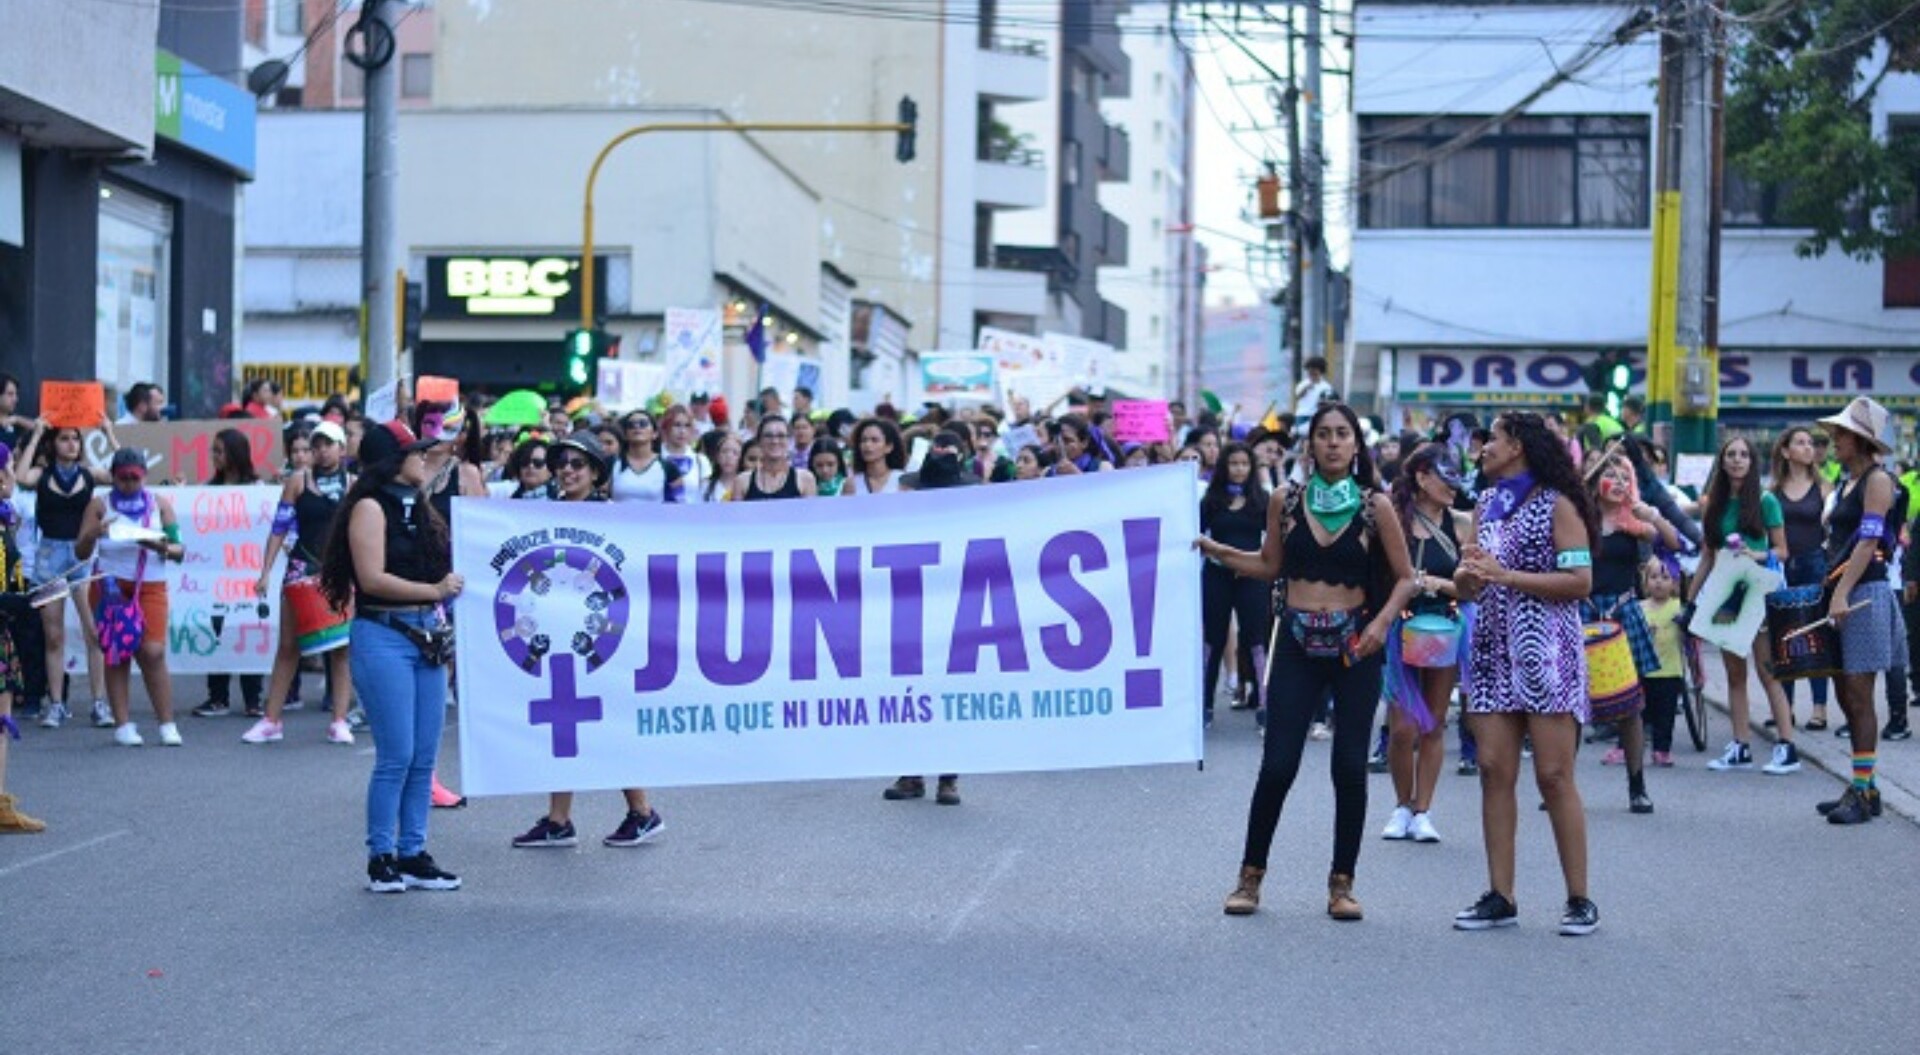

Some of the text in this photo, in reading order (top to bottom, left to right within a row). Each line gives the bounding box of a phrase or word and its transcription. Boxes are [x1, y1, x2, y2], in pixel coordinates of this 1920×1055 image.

[448, 258, 571, 297] BBC
[1791, 356, 1873, 389] LA
[634, 517, 1163, 710] JUNTAS!
[637, 686, 1113, 736] HASTA QUE NI UNA MÁS TENGA MIEDO
